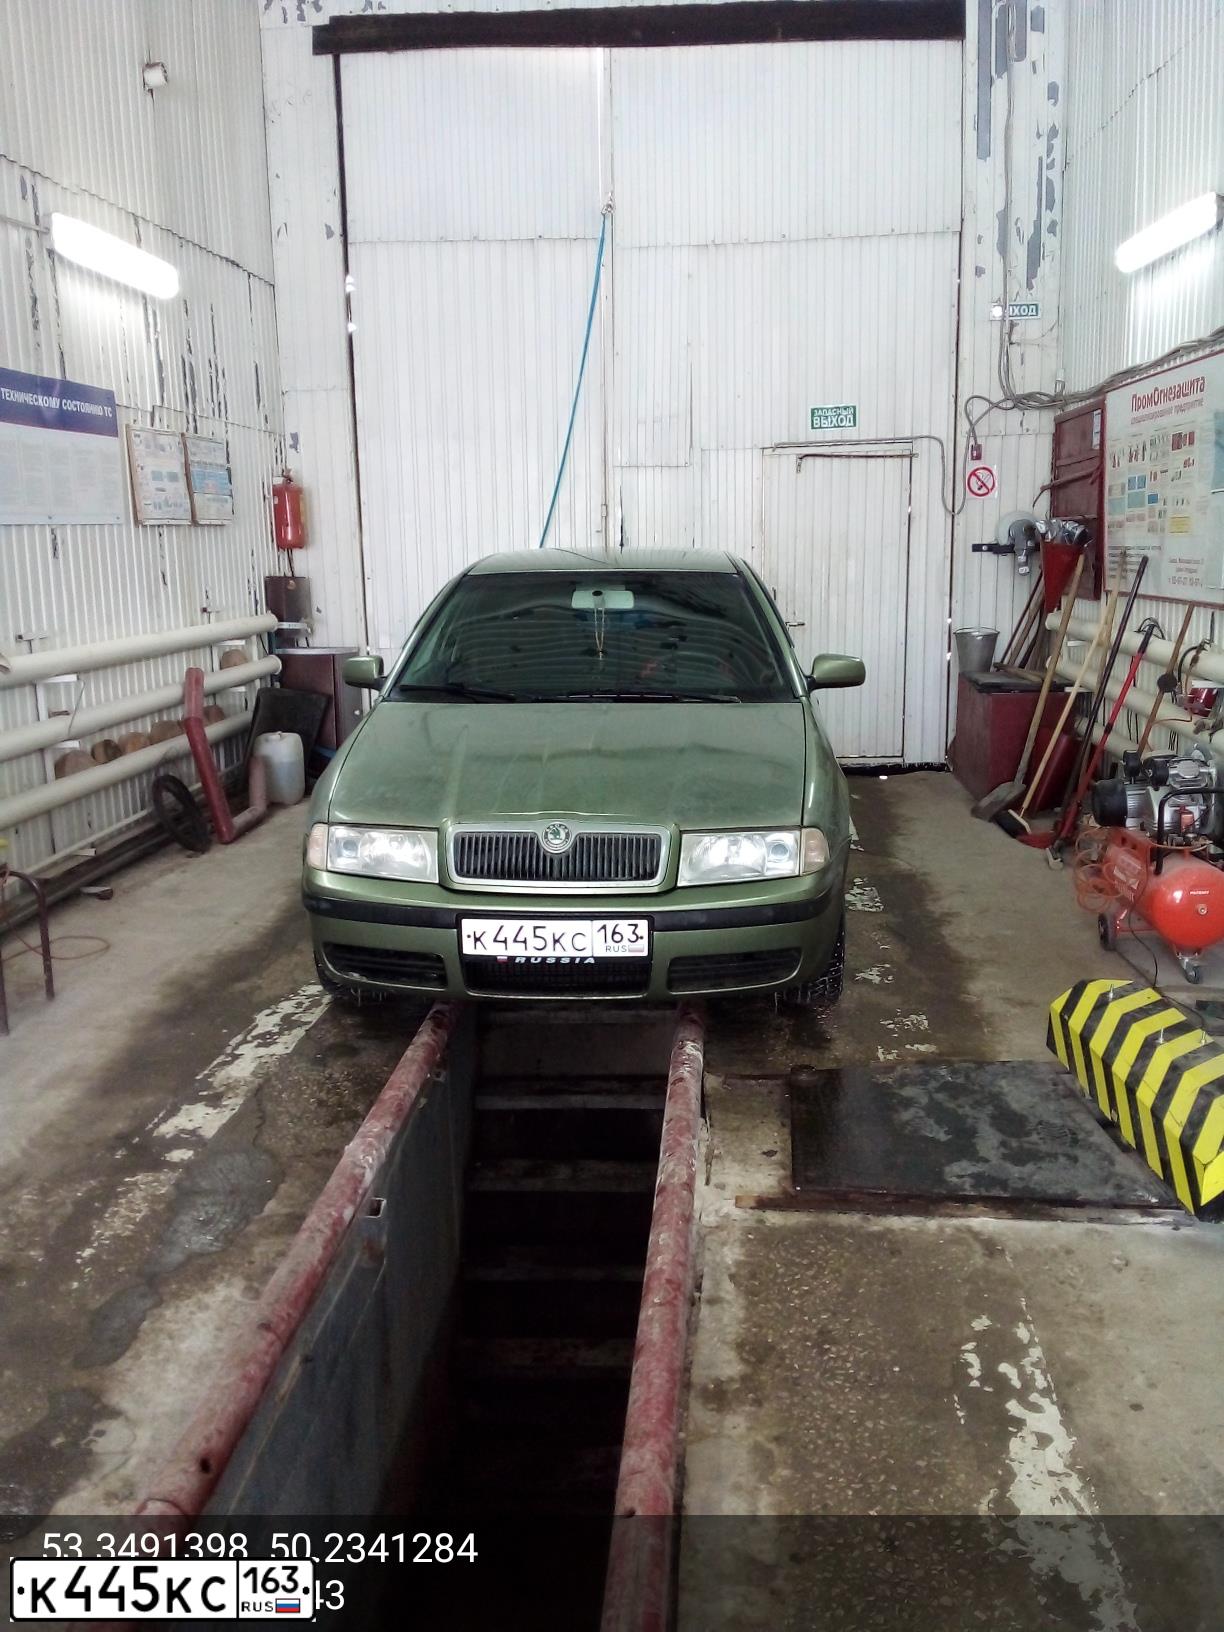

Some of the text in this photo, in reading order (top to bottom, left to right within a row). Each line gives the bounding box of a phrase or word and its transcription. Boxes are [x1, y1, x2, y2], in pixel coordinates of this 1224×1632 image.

[1131, 376, 1206, 412] ПромОгнезащита
[0, 387, 113, 417] ТЕХНИЧЕСКОМУ СОСТОЯНИЮ ТС
[813, 406, 854, 417] ЗАПАСНЫЙ
[813, 415, 854, 428] ВЫХОД
[596, 923, 640, 944] 163
[605, 940, 628, 953] RUS
[514, 956, 596, 964] RUSSIA
